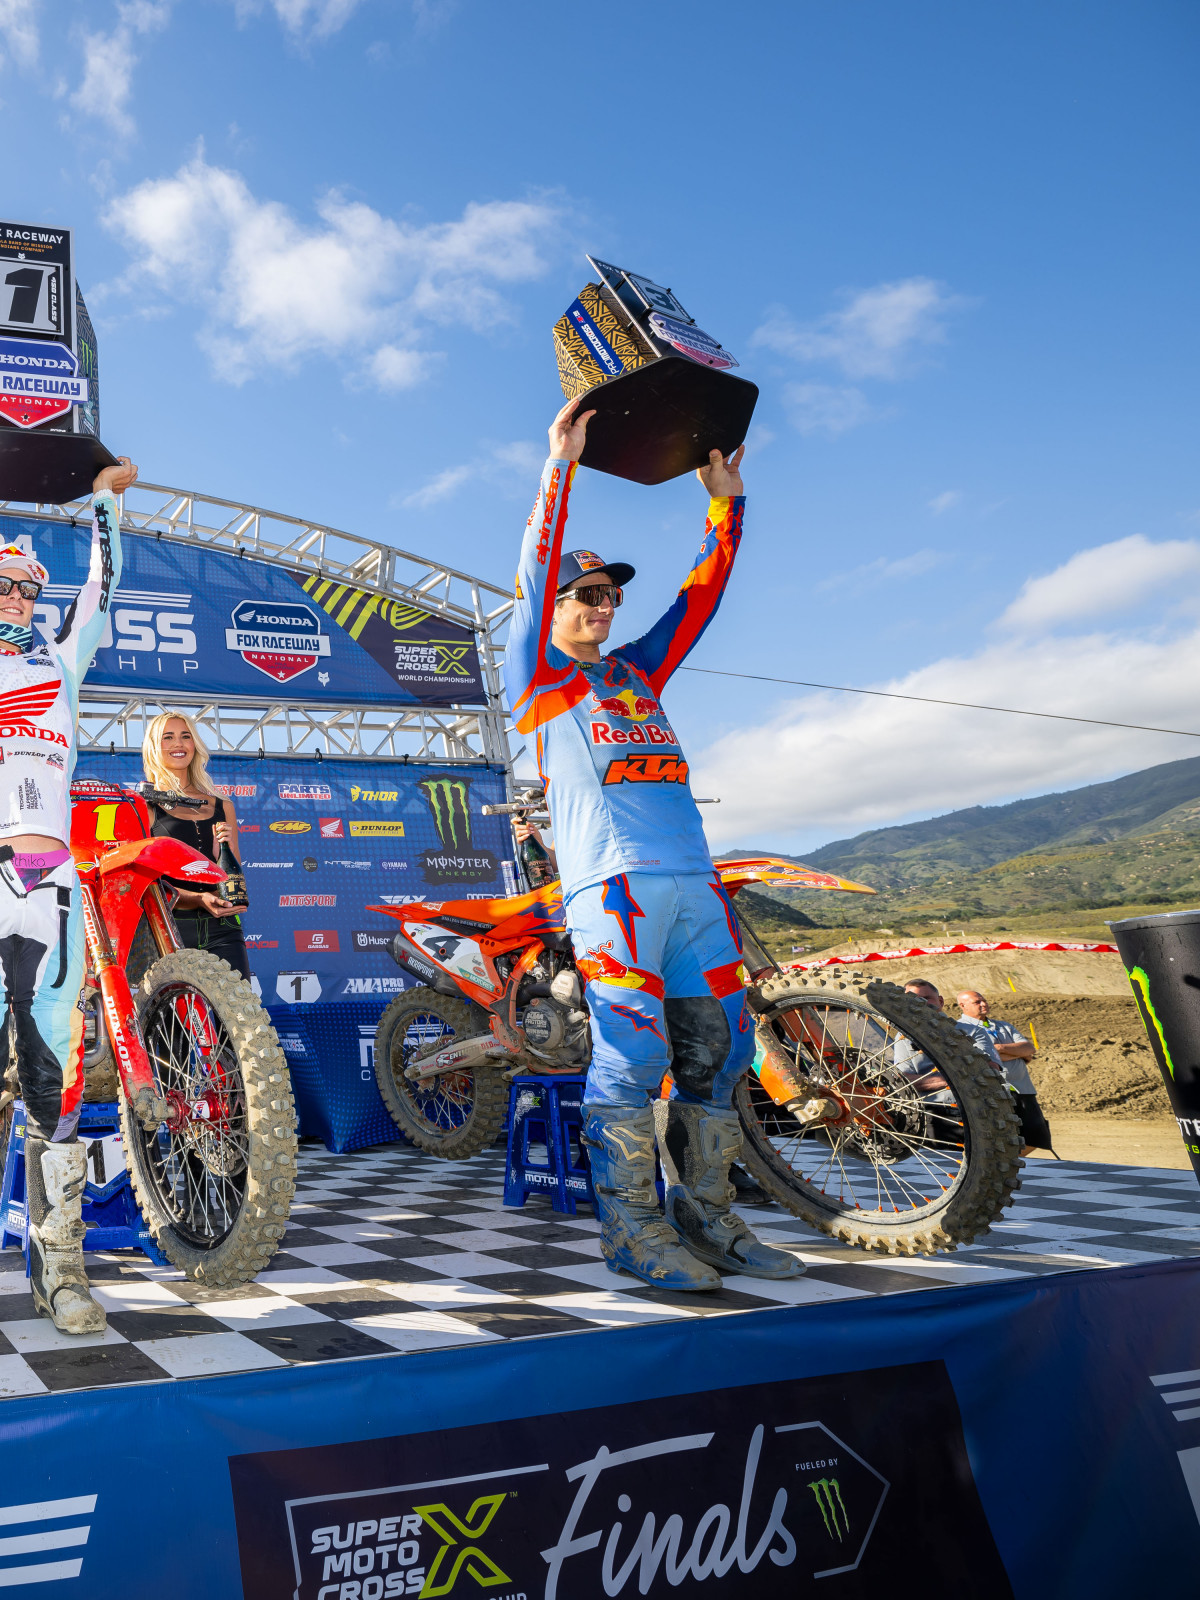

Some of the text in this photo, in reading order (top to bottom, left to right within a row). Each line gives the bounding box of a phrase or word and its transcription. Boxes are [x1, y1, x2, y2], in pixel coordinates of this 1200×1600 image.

[6, 229, 64, 245] RACEWAY
[4, 267, 44, 324] 1
[2, 377, 81, 396] RACEWAY
[536, 467, 561, 566] alpinestars
[95, 502, 115, 614] alpinestars
[256, 614, 314, 627] HONDA
[237, 633, 320, 651] FOX RACEWAY
[394, 645, 437, 655] SUPER
[251, 653, 309, 664] NATIONAL
[395, 662, 438, 672] CROSS
[398, 654, 436, 664] MOTO
[398, 674, 476, 684] WORLD CHAMPIONSHIP
[590, 722, 647, 745] Red
[602, 754, 689, 786] KTM
[279, 784, 330, 794] PARTS
[361, 791, 399, 801] THOR
[92, 803, 122, 841] 1
[269, 822, 312, 834] FMF
[427, 856, 491, 869] MONSTER
[279, 895, 337, 907] MOTOSPORT
[422, 936, 461, 962] 4
[342, 978, 404, 994] AMA PRO
[104, 995, 133, 1073] DUNLOP
[795, 1458, 839, 1472] FUELED BY
[539, 1423, 797, 1600] Finals
[311, 1513, 424, 1554] SUPER
[322, 1540, 421, 1582] MOTO
[316, 1568, 426, 1600] CROSS
